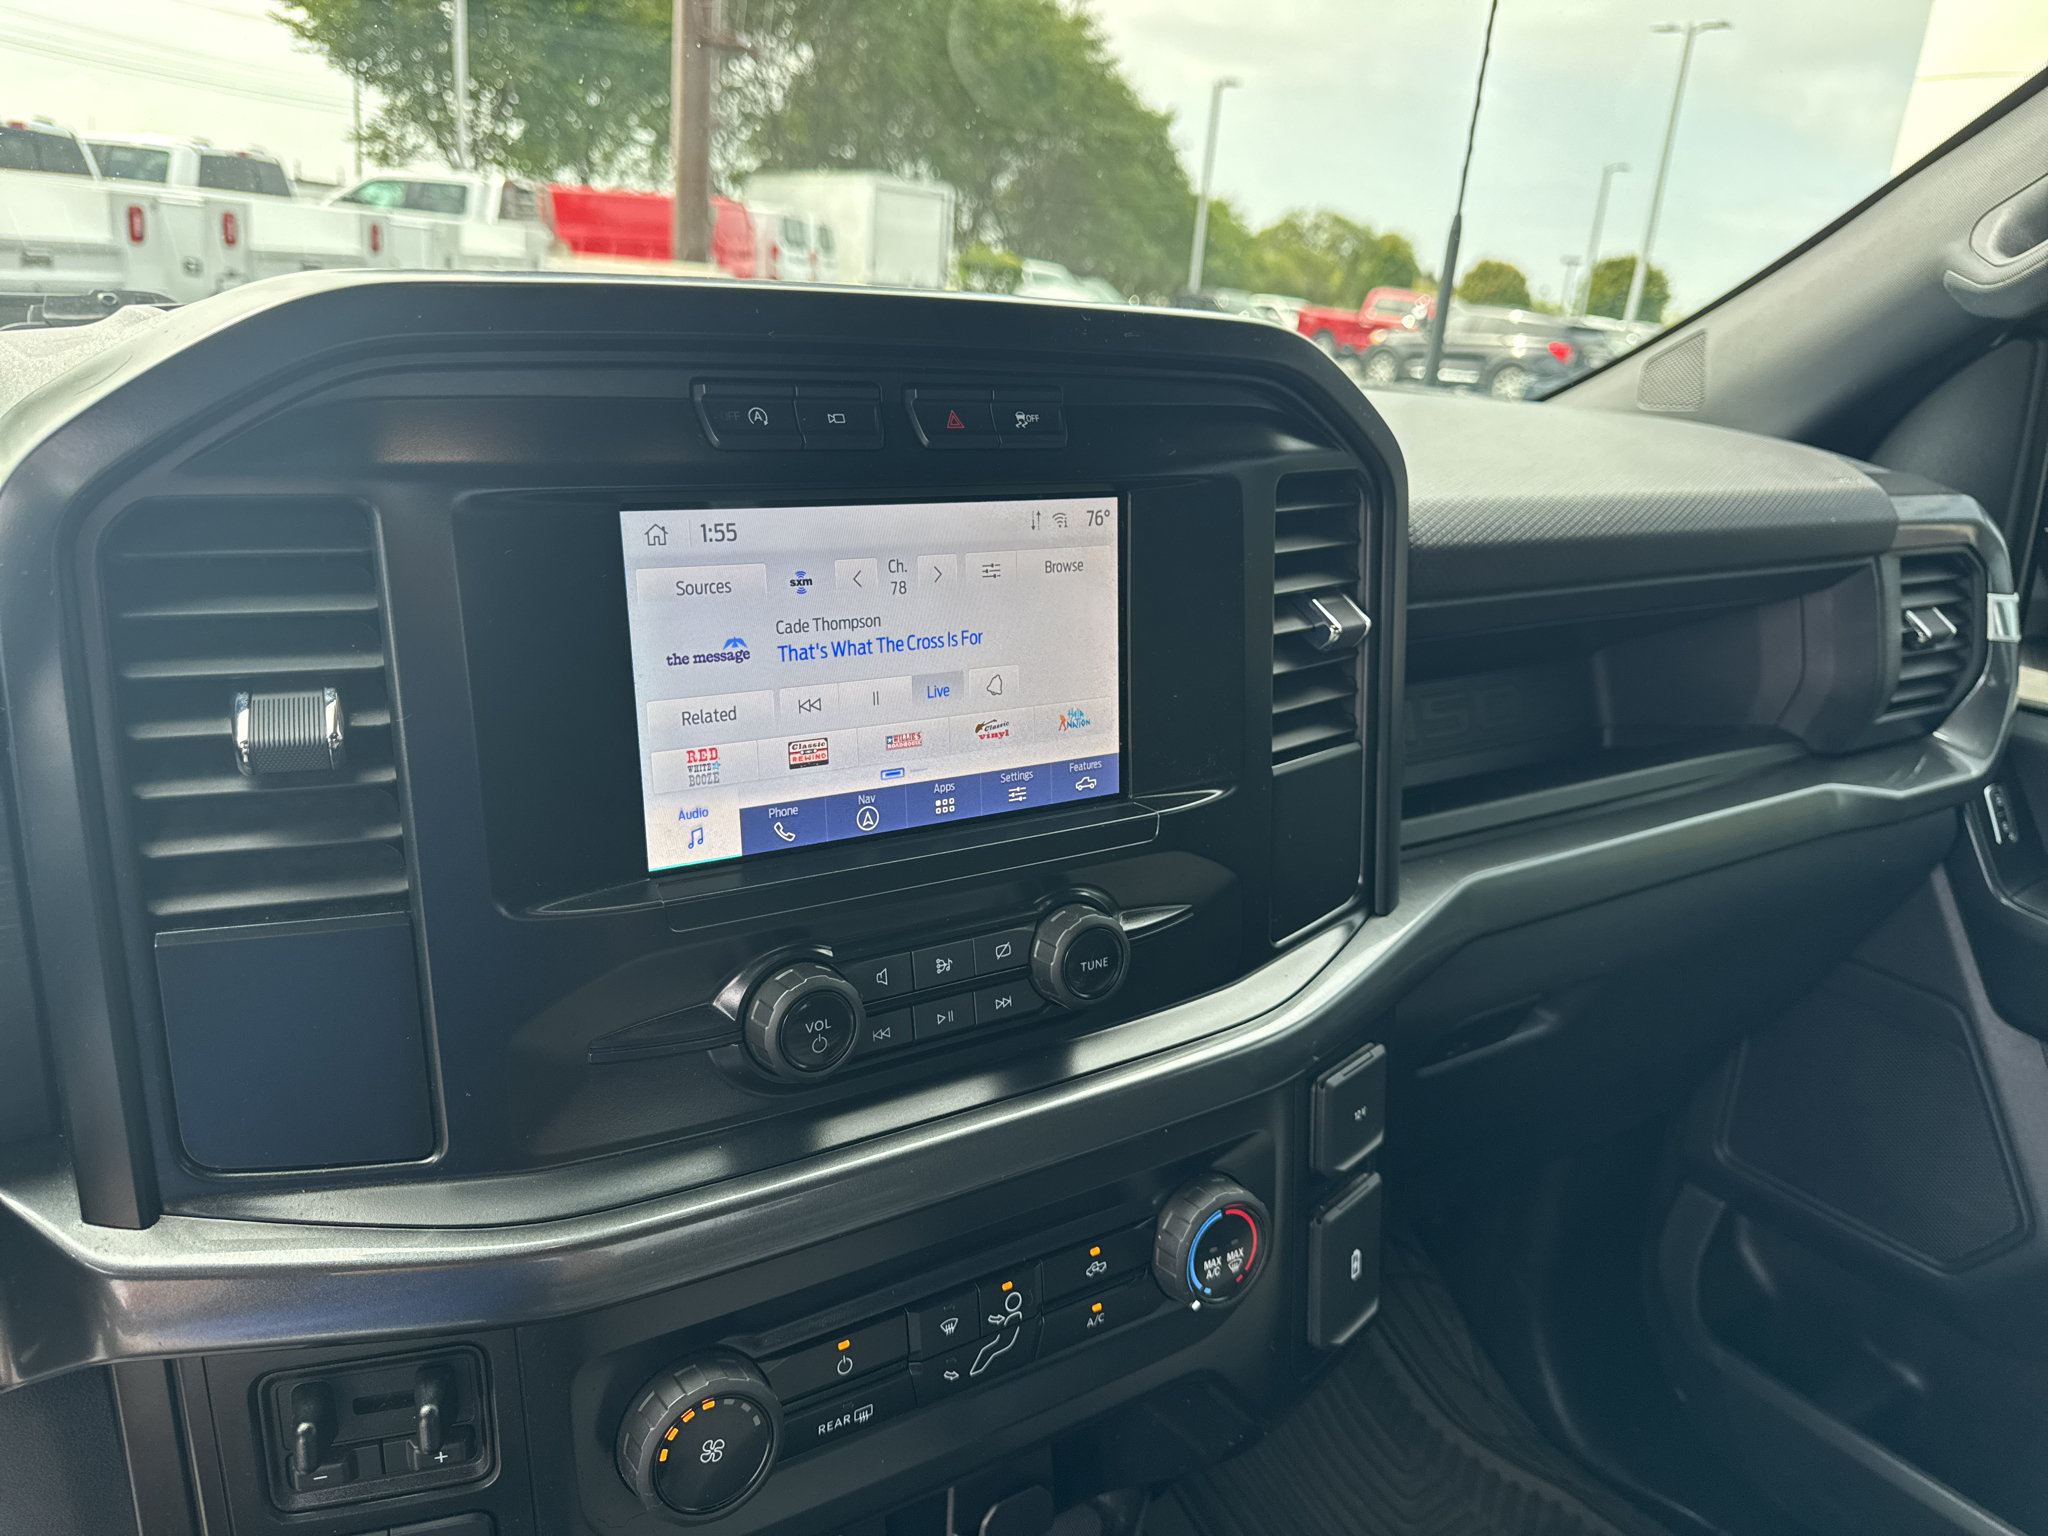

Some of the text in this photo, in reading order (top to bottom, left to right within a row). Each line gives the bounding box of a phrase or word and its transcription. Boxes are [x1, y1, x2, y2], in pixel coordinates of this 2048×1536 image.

[1026, 414, 1039, 423] OFF
[1086, 509, 1111, 527] 76°
[700, 522, 738, 543] 1:55
[888, 558, 908, 574] Ch.
[1045, 559, 1084, 574] Browse
[676, 580, 733, 597] Sources
[789, 578, 813, 588] sxm
[890, 580, 907, 596] 78
[776, 614, 882, 636] Cade Thompson
[777, 629, 984, 663] That's What The Cross Is For
[666, 648, 751, 666] the message
[927, 685, 951, 699] Live
[681, 705, 738, 727] Related
[984, 720, 1010, 732] Classic
[979, 729, 1010, 741] vinyl
[791, 740, 826, 752] Classic
[686, 747, 719, 764] RED
[687, 763, 712, 774] WHITE
[1069, 759, 1103, 773] Features
[689, 771, 720, 788] BOOZE
[1000, 769, 1034, 784] Settings
[933, 782, 956, 795] Apps
[858, 794, 876, 806] Nav
[678, 807, 709, 821] Audio
[768, 804, 799, 819] Phone
[1080, 956, 1109, 972] TUNE
[805, 1018, 832, 1034] VOL
[1226, 1247, 1244, 1262] MAX
[1203, 1255, 1222, 1271] MAX
[1206, 1266, 1221, 1280] A/C
[1086, 1312, 1105, 1328] A/C
[818, 1414, 851, 1435] REAR
